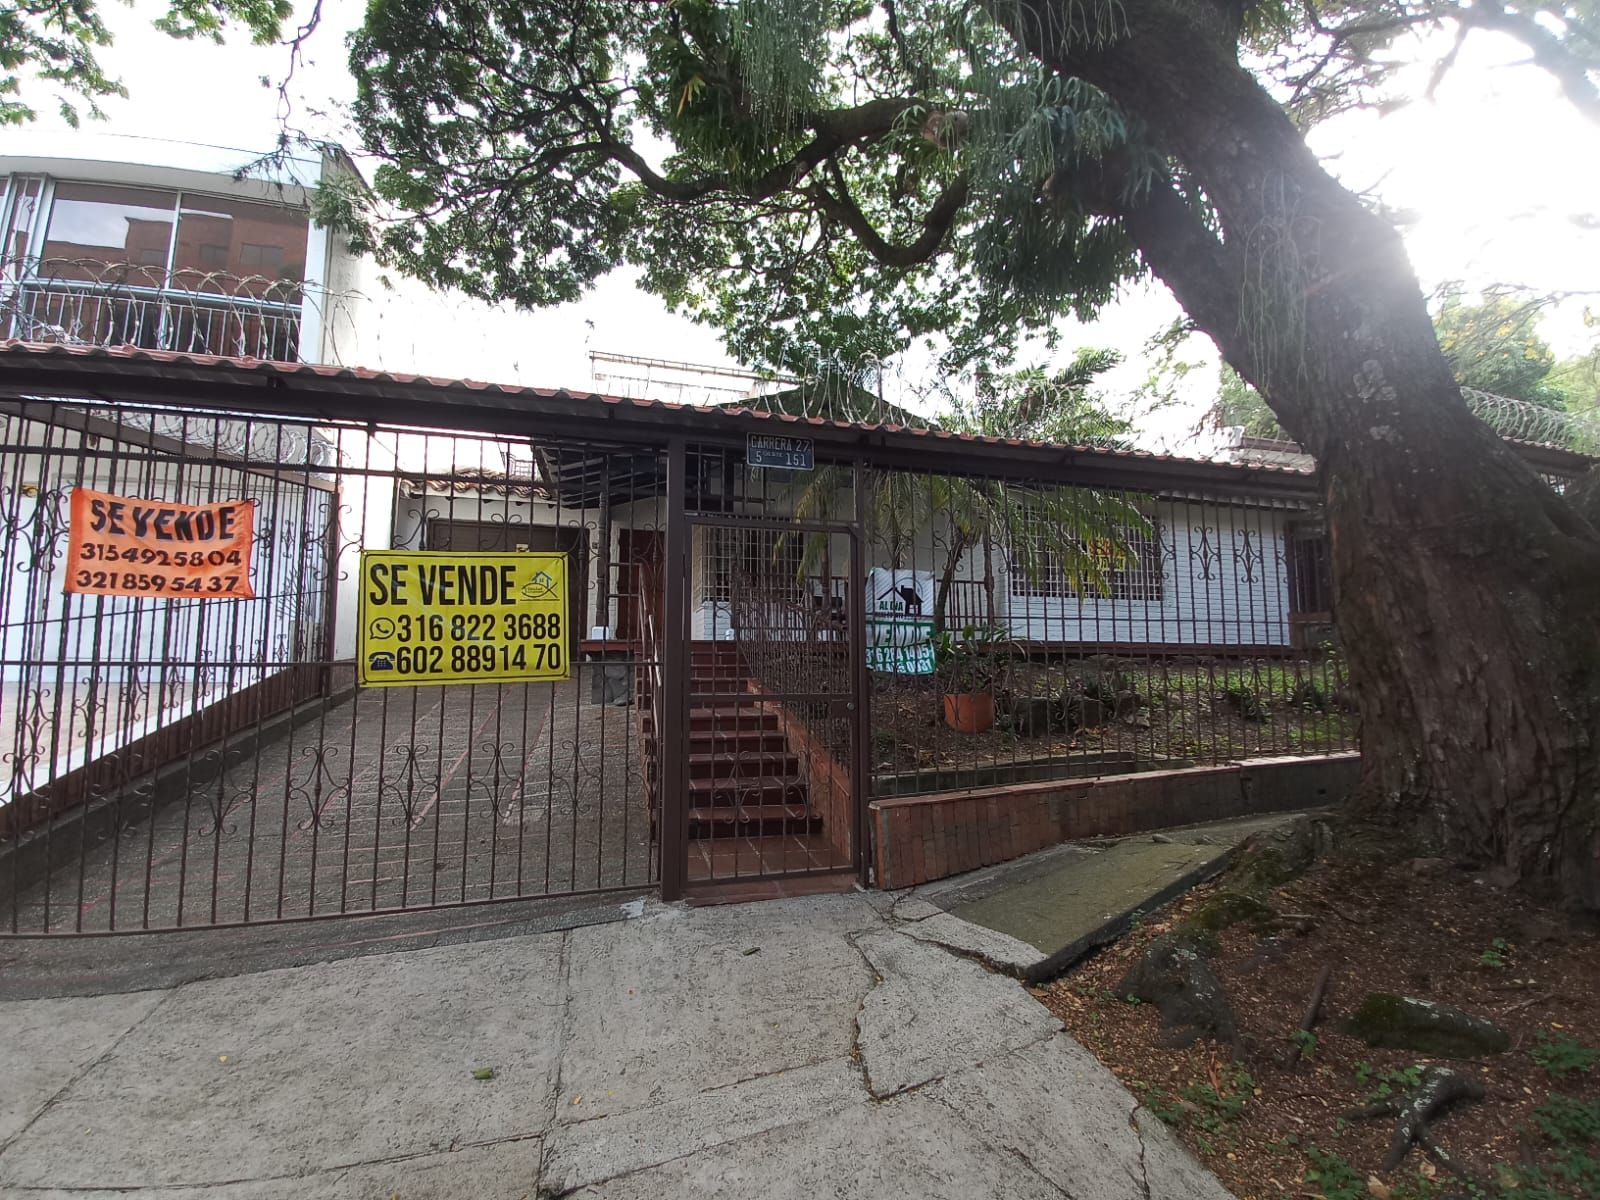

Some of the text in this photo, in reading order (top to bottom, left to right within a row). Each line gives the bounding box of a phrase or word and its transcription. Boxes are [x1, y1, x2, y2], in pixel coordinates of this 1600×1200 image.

[751, 435, 810, 452] CARRERA 27
[756, 451, 762, 463] 5
[786, 453, 806, 467] 151
[90, 499, 236, 542] SE VENDE
[369, 563, 516, 606] SE VENDE
[397, 613, 560, 642] 316 822 3688
[396, 646, 443, 674] 602
